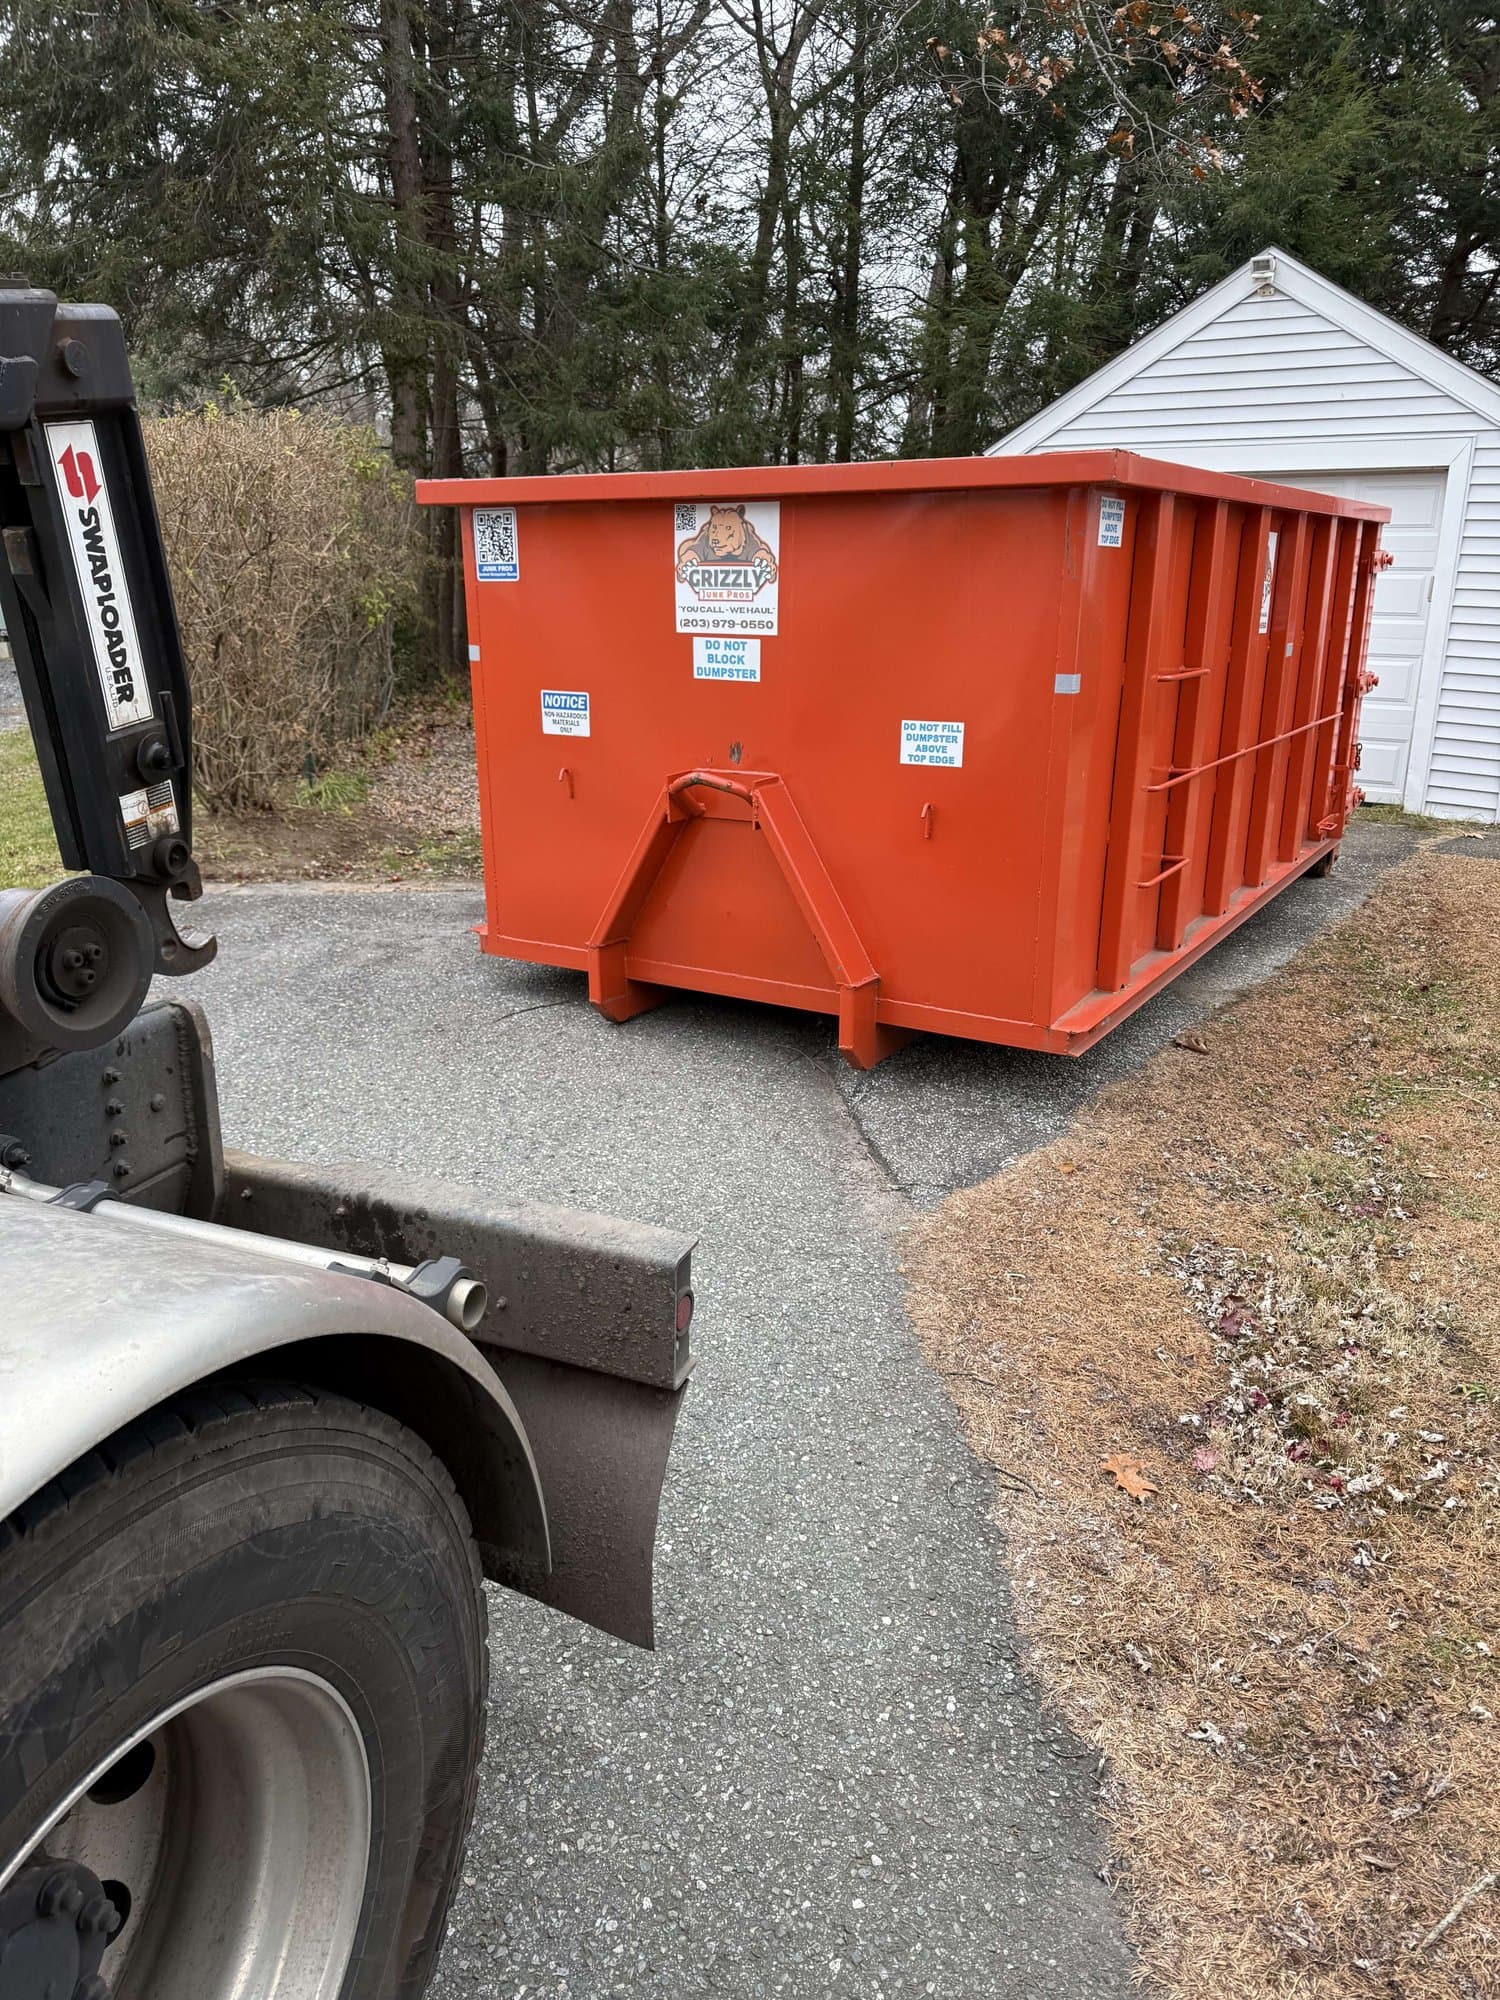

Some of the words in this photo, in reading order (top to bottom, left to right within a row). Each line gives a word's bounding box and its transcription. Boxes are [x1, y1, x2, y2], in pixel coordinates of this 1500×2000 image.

[688, 568, 765, 588] GRIZZLY
[702, 590, 723, 599] JUNK
[726, 590, 750, 599] PROS
[78, 506, 135, 705] SWAPLOADER
[729, 606, 745, 614] WE
[680, 618, 710, 629] (203)
[711, 619, 774, 630] 979-0550
[705, 640, 721, 650] DO
[724, 641, 748, 651] NOT
[707, 653, 745, 665] BLOCK
[696, 666, 757, 680] DUMPSTER
[544, 694, 587, 709] NOTICE
[552, 718, 581, 727] MATERIALS
[903, 722, 917, 731] DO
[919, 723, 940, 732] NOT
[941, 724, 962, 733] FILL
[560, 726, 573, 734] ONLY
[906, 733, 958, 744] DUMPSTER
[915, 744, 948, 753] ABOVE
[907, 754, 927, 763] TOP
[928, 755, 955, 764] EDGE
